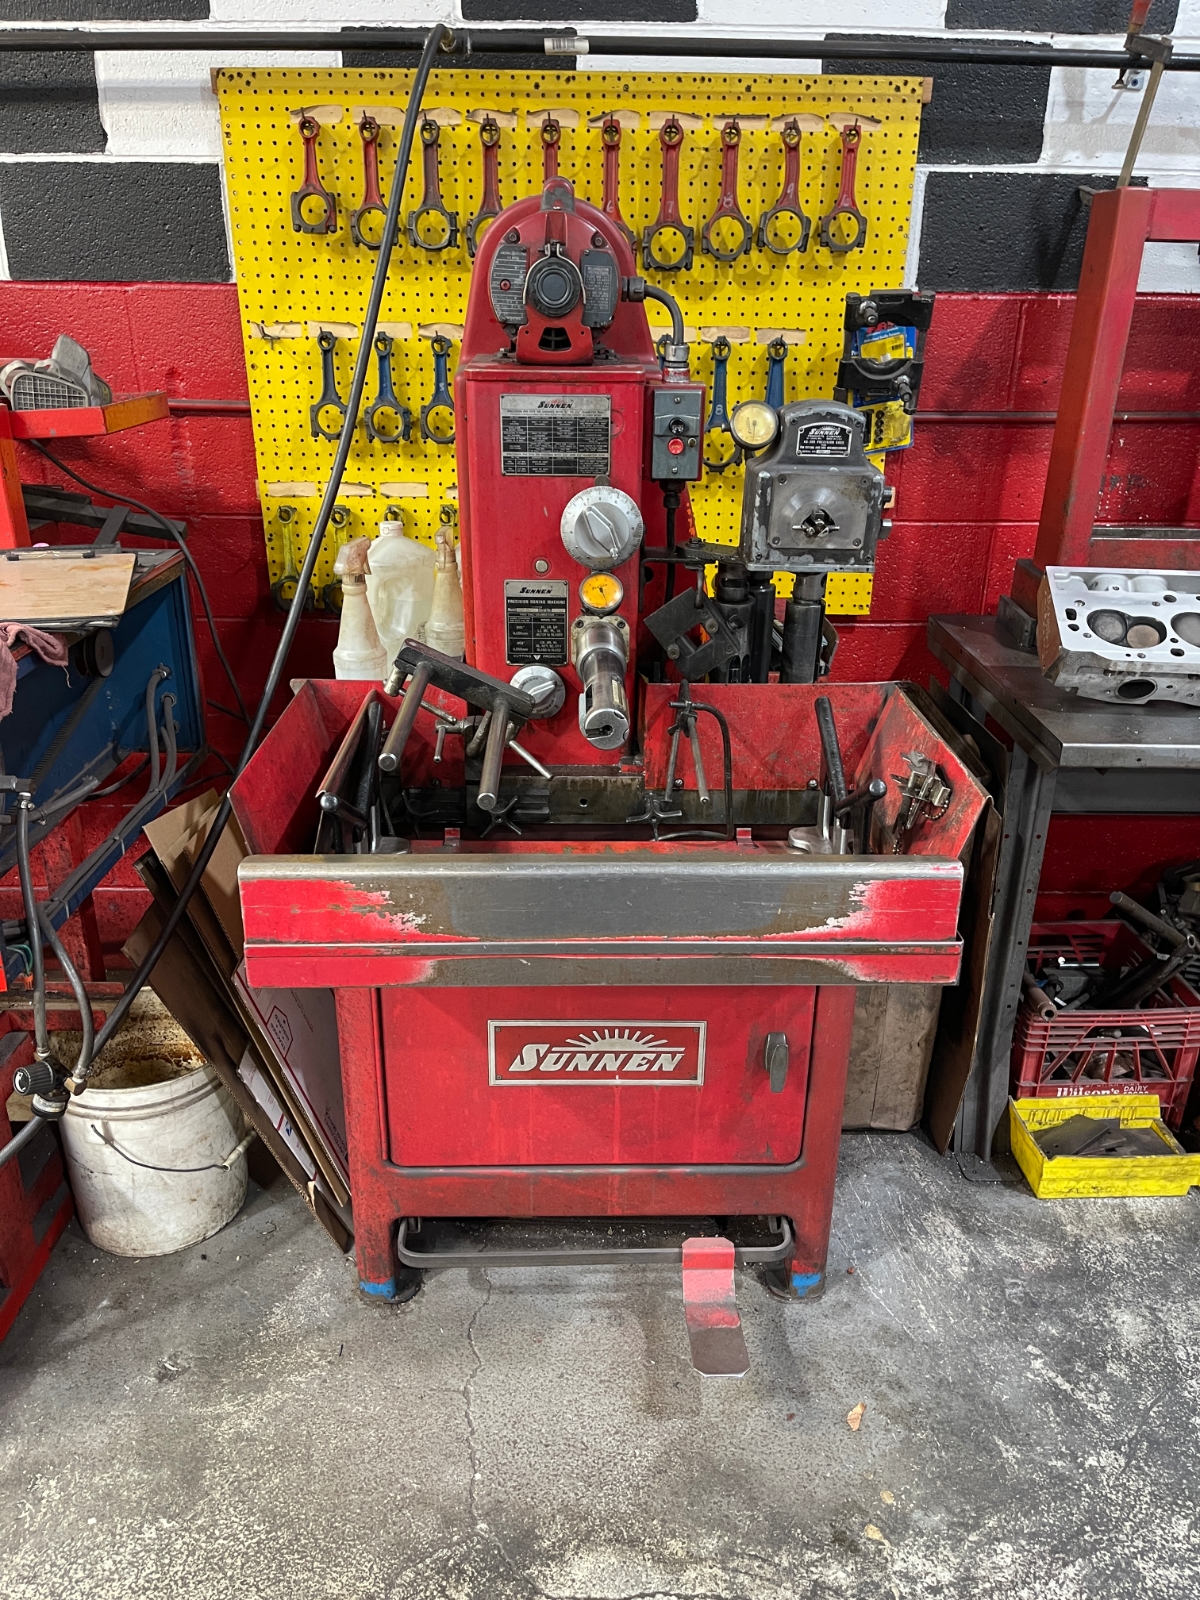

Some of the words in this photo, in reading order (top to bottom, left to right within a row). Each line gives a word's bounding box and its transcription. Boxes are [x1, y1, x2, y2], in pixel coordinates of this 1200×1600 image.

[786, 182, 796, 198] 9
[606, 199, 613, 213] 6
[667, 200, 674, 213] 7
[537, 400, 574, 409] SUNNEN
[715, 404, 723, 415] 8
[508, 1044, 685, 1072] SUNNEN
